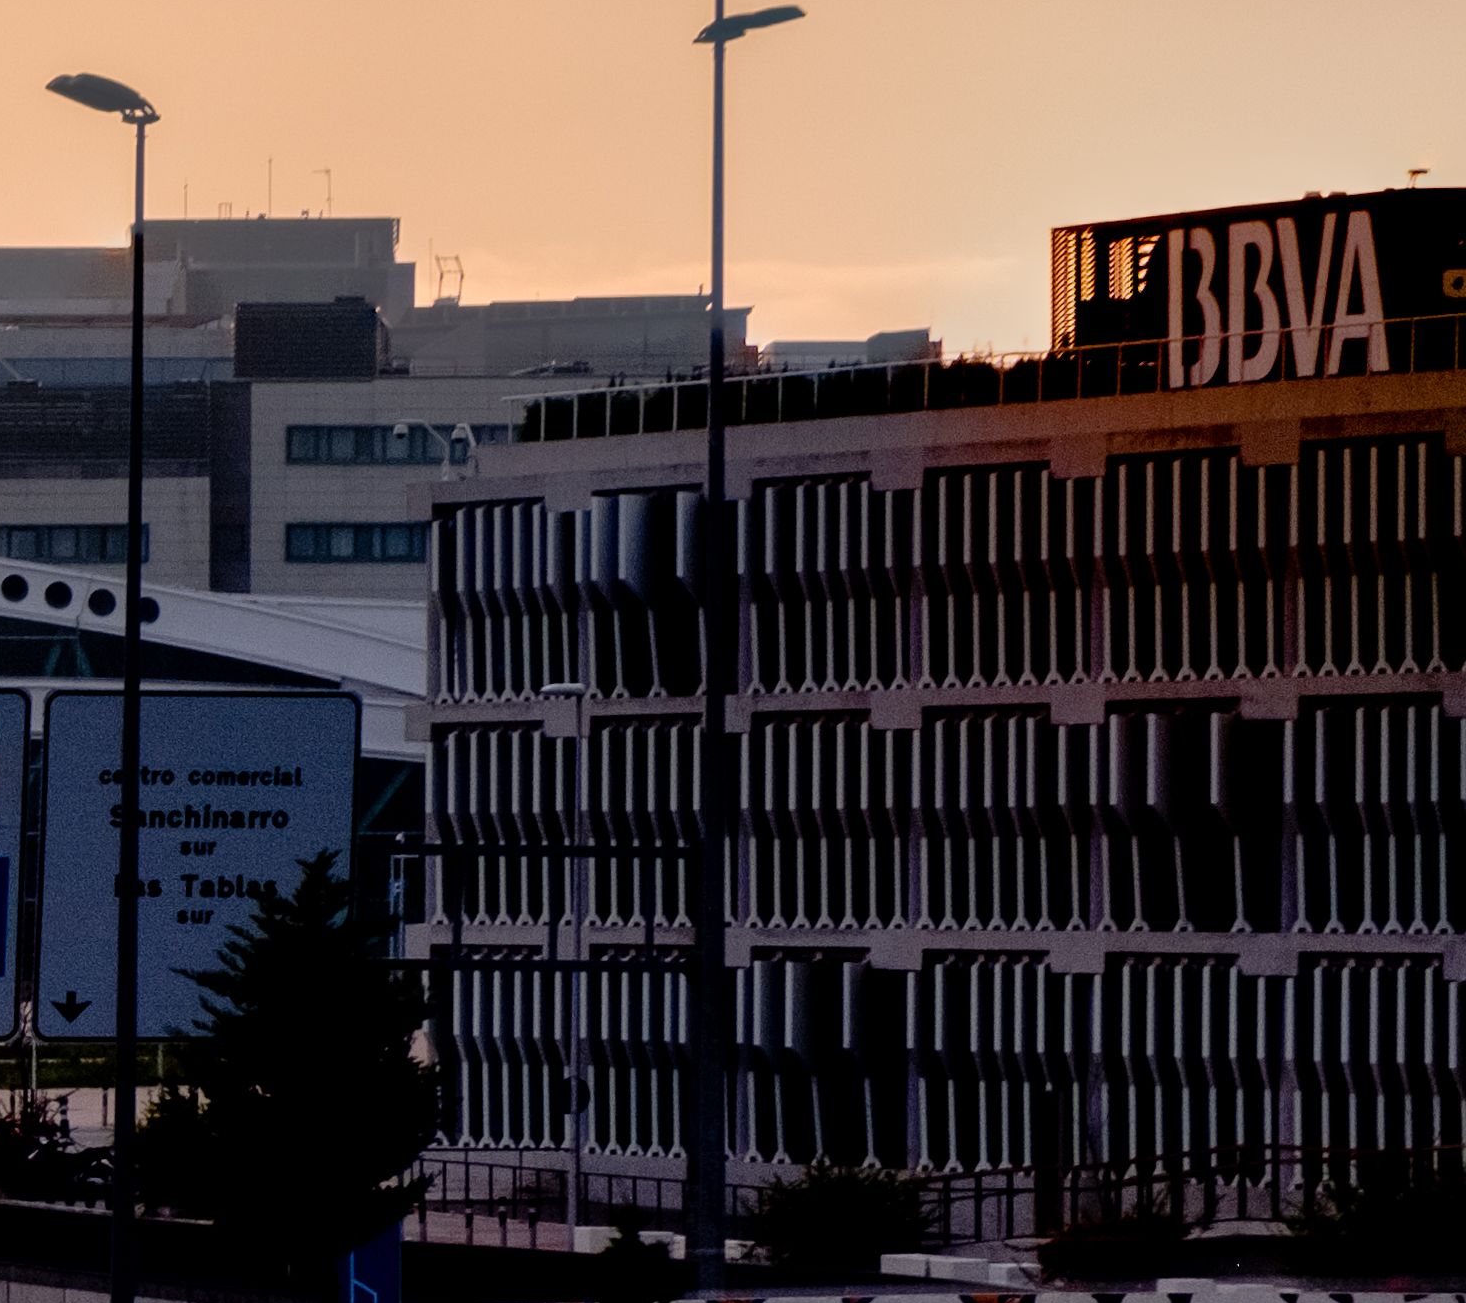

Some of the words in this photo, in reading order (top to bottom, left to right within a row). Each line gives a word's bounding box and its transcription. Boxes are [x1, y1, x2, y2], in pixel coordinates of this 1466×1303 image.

[1166, 209, 1391, 390] BBVA
[99, 768, 175, 786] cetro
[187, 766, 303, 786] comercial
[179, 841, 217, 856] sur
[180, 874, 279, 899] Tablas
[177, 909, 214, 924] sur
